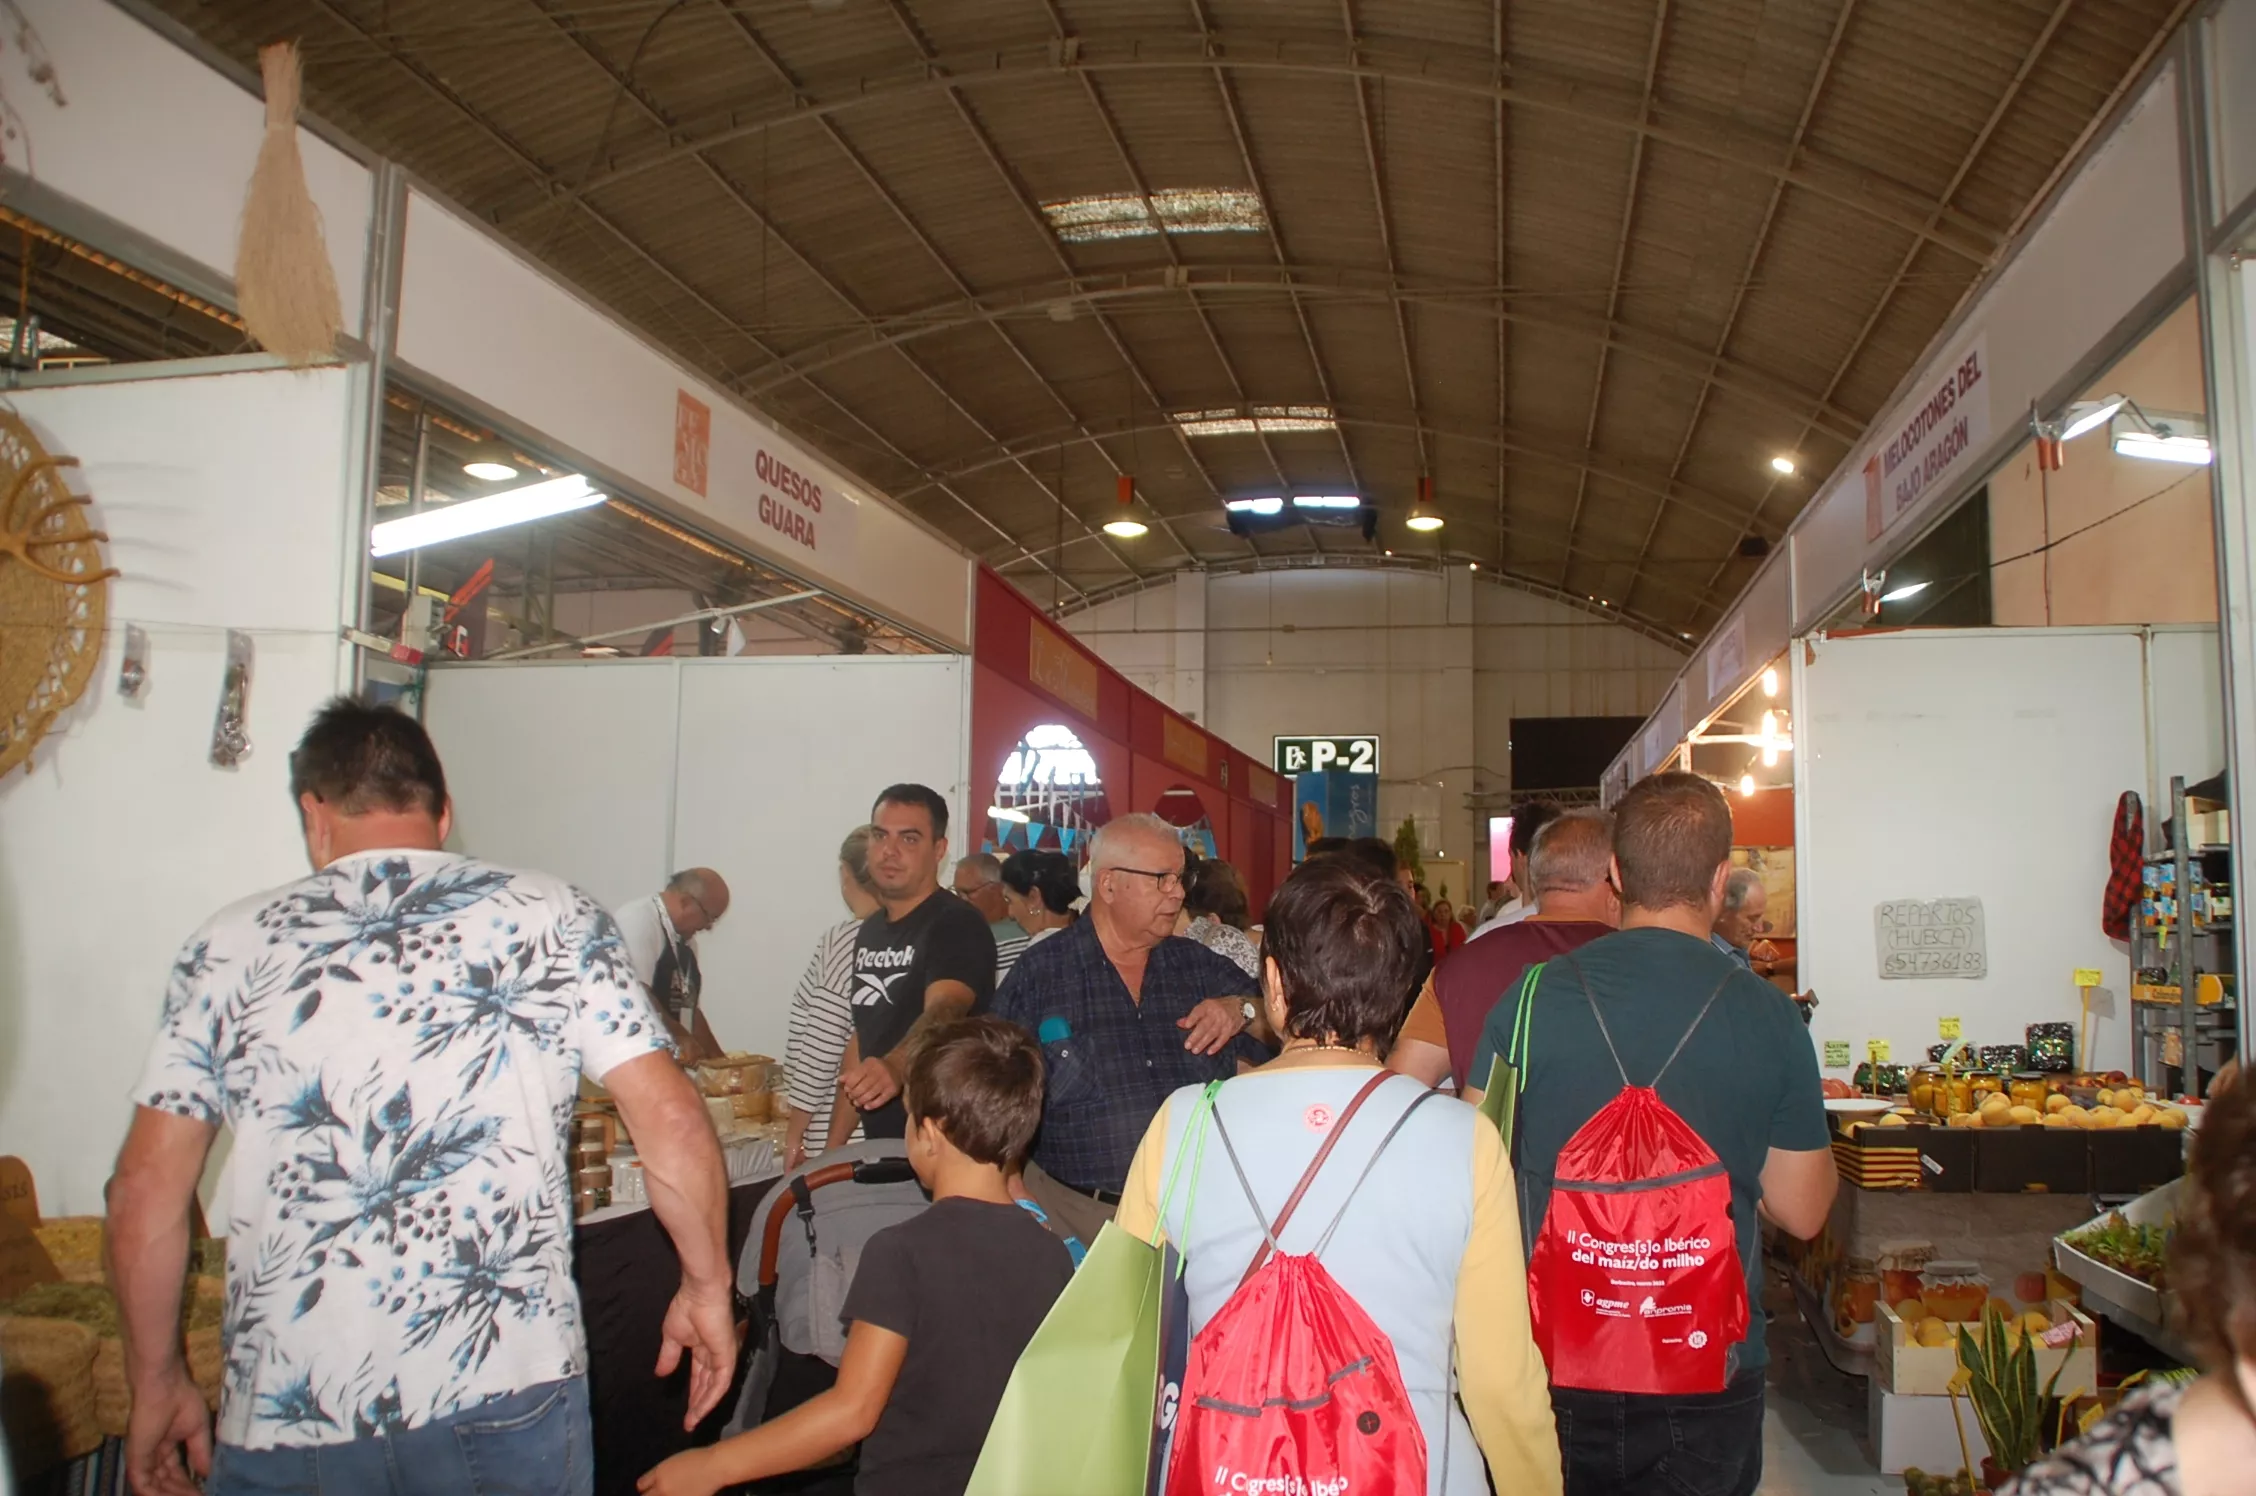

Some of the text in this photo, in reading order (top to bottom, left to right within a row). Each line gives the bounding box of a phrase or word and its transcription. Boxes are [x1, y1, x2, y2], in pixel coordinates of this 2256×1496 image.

[1957, 350, 1982, 399] DEL
[1896, 464, 1921, 511] BAJO
[1923, 416, 1969, 487] ARAGÓN
[755, 449, 822, 514] QUESOS
[758, 494, 817, 550] GUARA
[1312, 740, 1374, 773] P-2
[1880, 902, 1977, 926] REPARTOS
[855, 945, 916, 971] Reebok
[1571, 1249, 1705, 1271] del maíz/do milho
[1579, 1232, 1661, 1257] Congres[s]o
[1664, 1236, 1711, 1253] Ibérico
